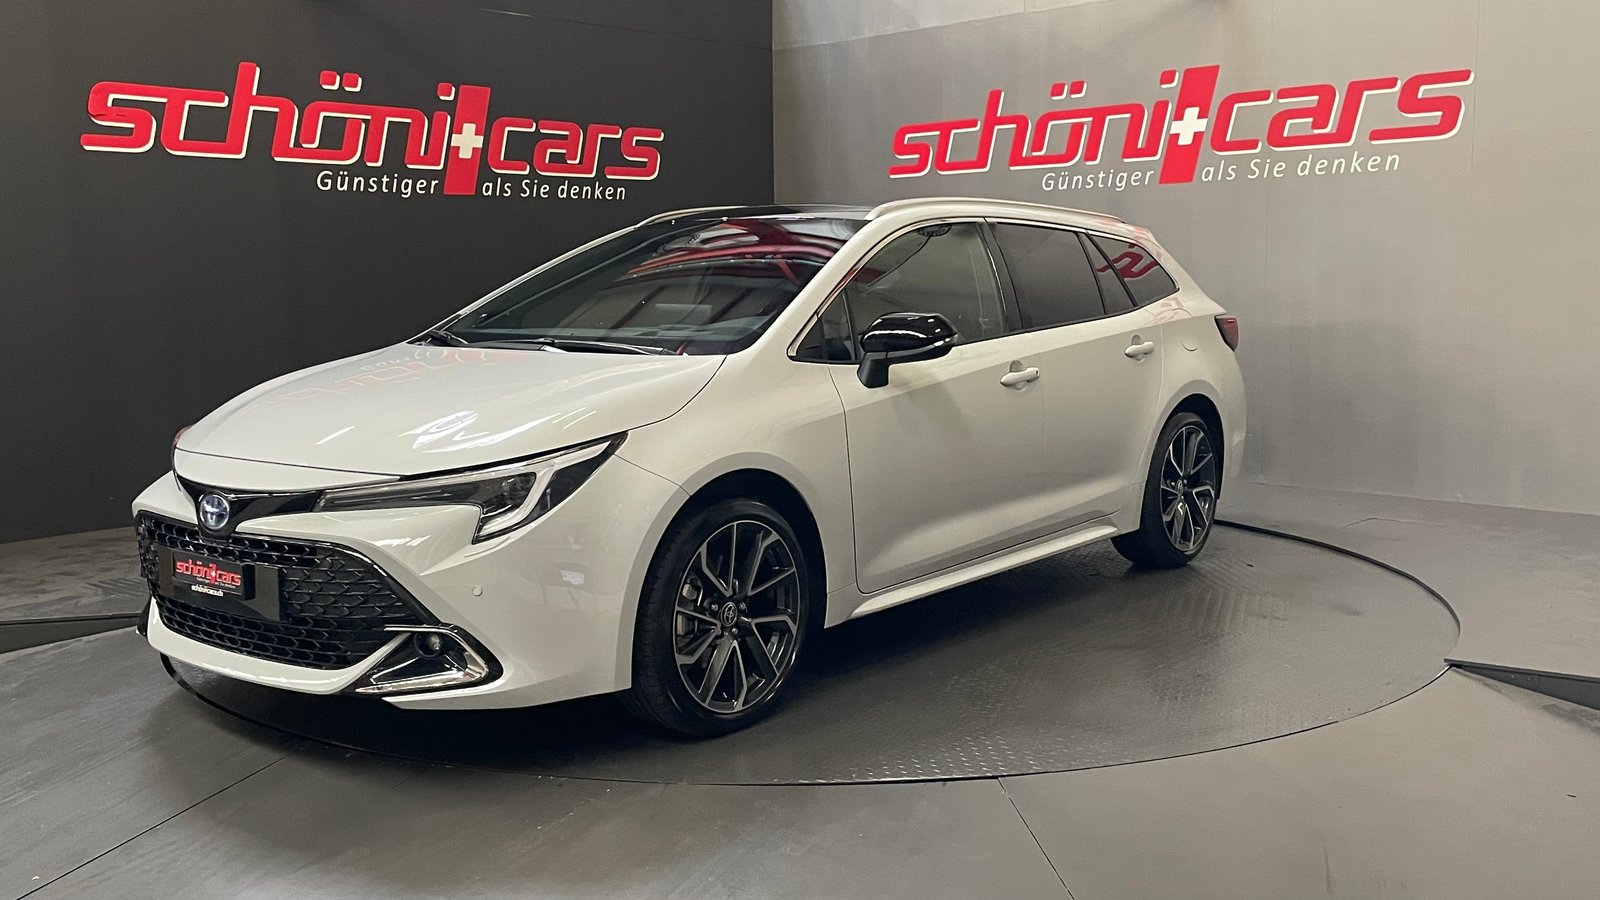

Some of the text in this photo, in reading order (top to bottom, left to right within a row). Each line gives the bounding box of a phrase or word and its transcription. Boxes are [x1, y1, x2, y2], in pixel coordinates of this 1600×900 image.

[316, 169, 626, 201] Günstiger als Sie denken
[1042, 151, 1400, 192] Günstiger als Sie denken
